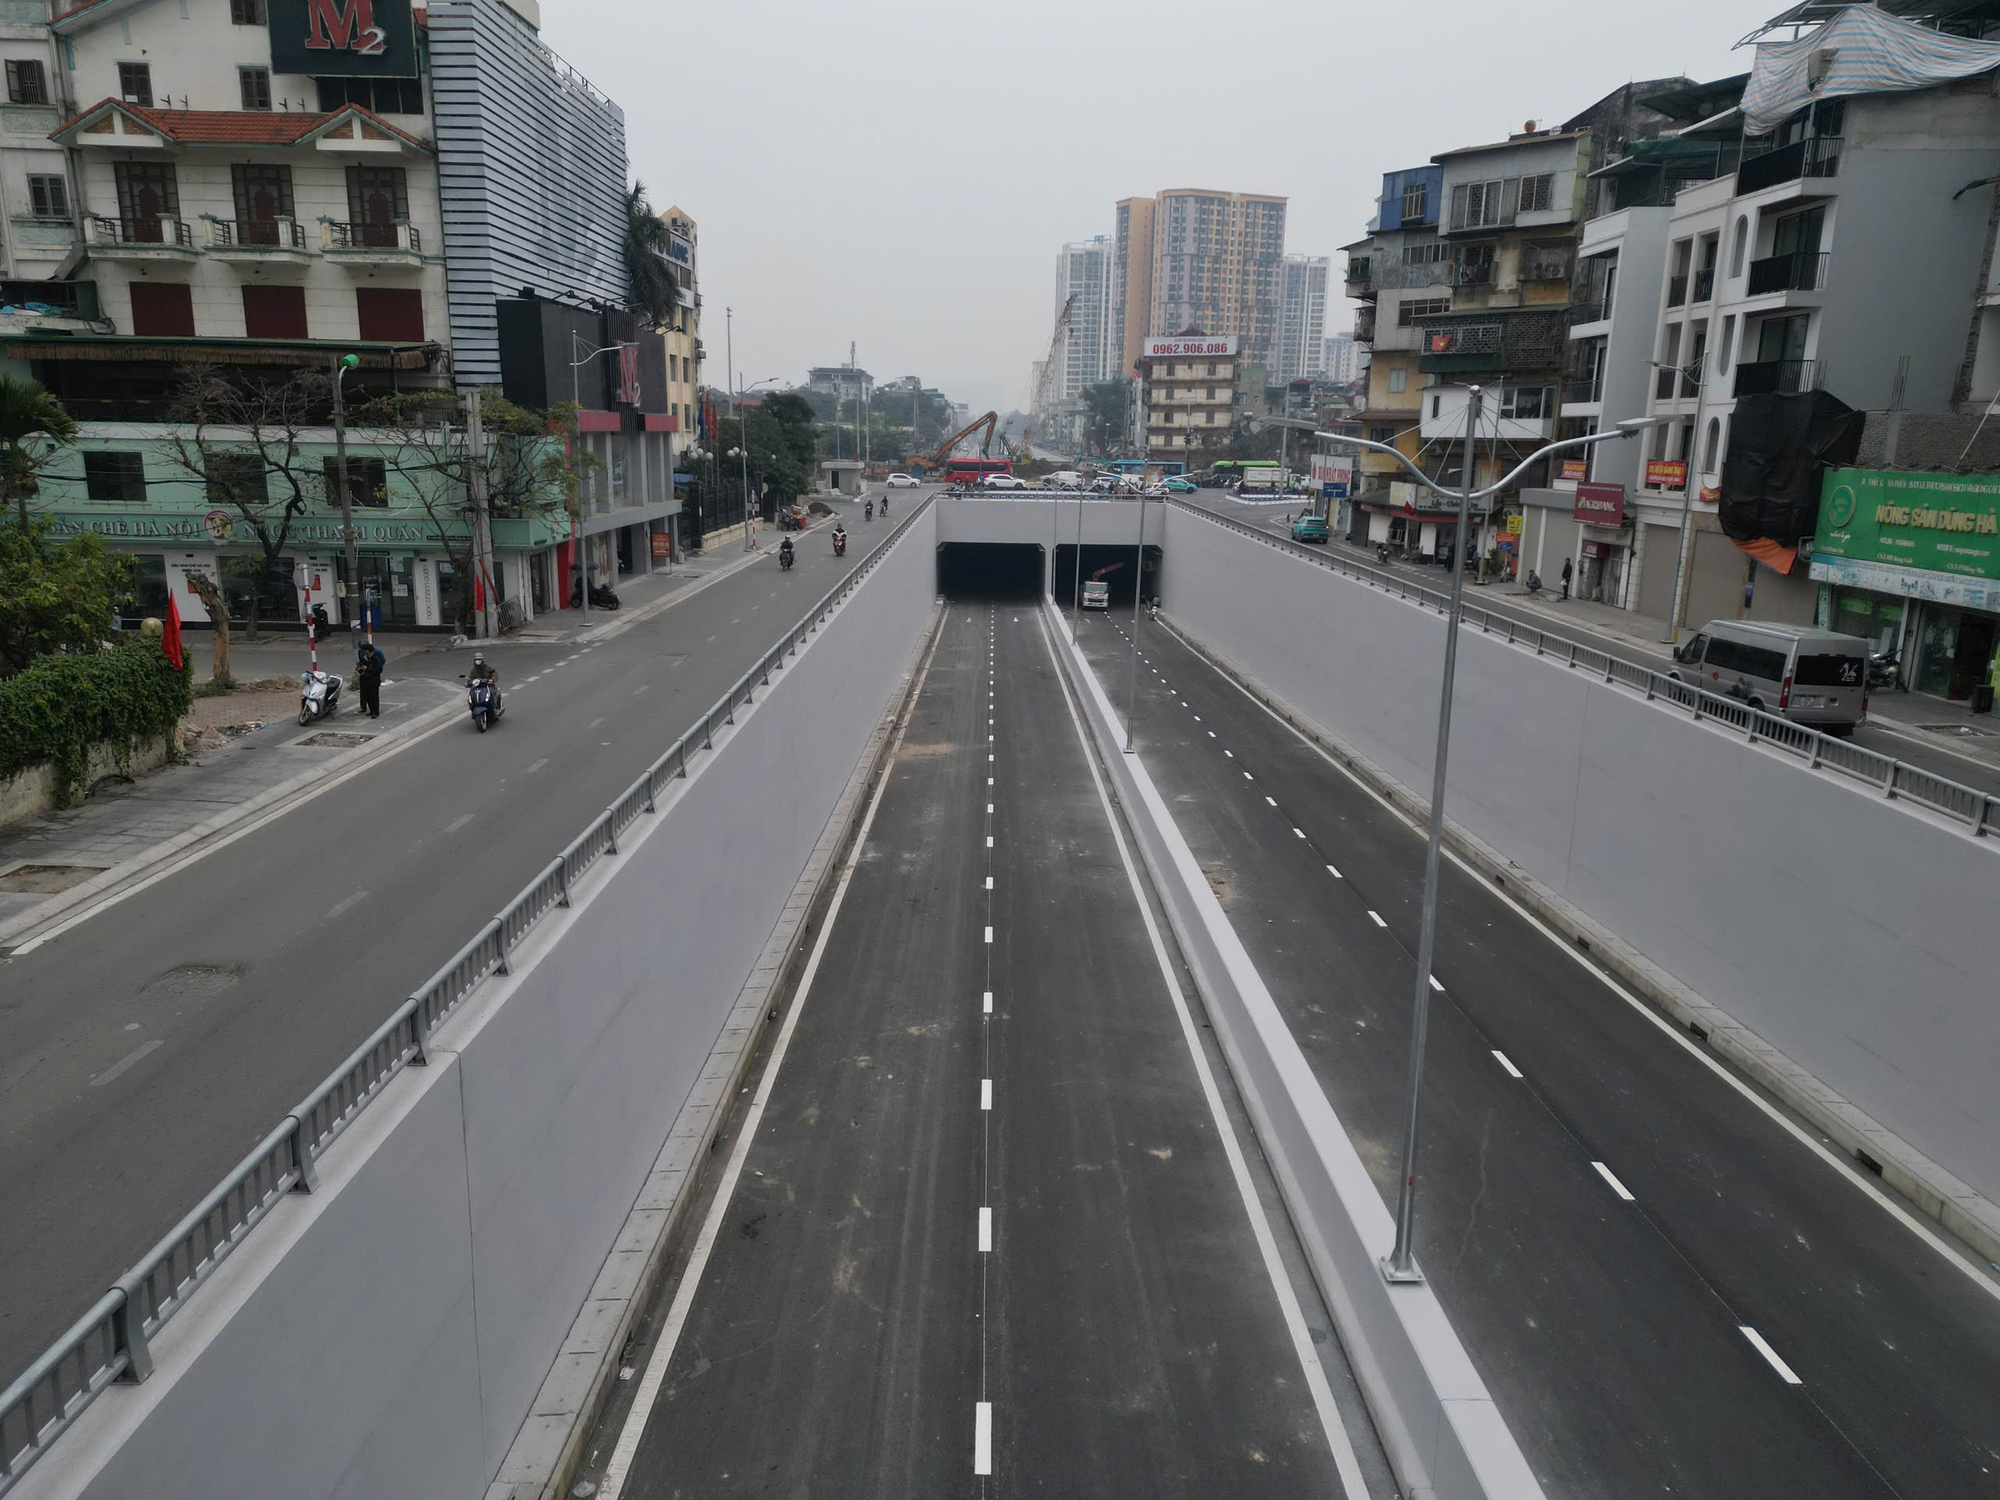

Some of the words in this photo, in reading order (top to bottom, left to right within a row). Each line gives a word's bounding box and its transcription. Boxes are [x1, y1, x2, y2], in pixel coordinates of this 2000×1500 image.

[1153, 343, 1227, 354] 0962.906.086
[1875, 500, 1911, 526] NÔNG
[1911, 503, 1937, 529] SẢN
[1937, 507, 1975, 533] DŨNG
[89, 518, 129, 536] CHÈ
[133, 519, 161, 537] HÀ
[166, 518, 199, 539] NỘI
[304, 524, 368, 542] THẠH
[373, 523, 423, 543] QUÁN
